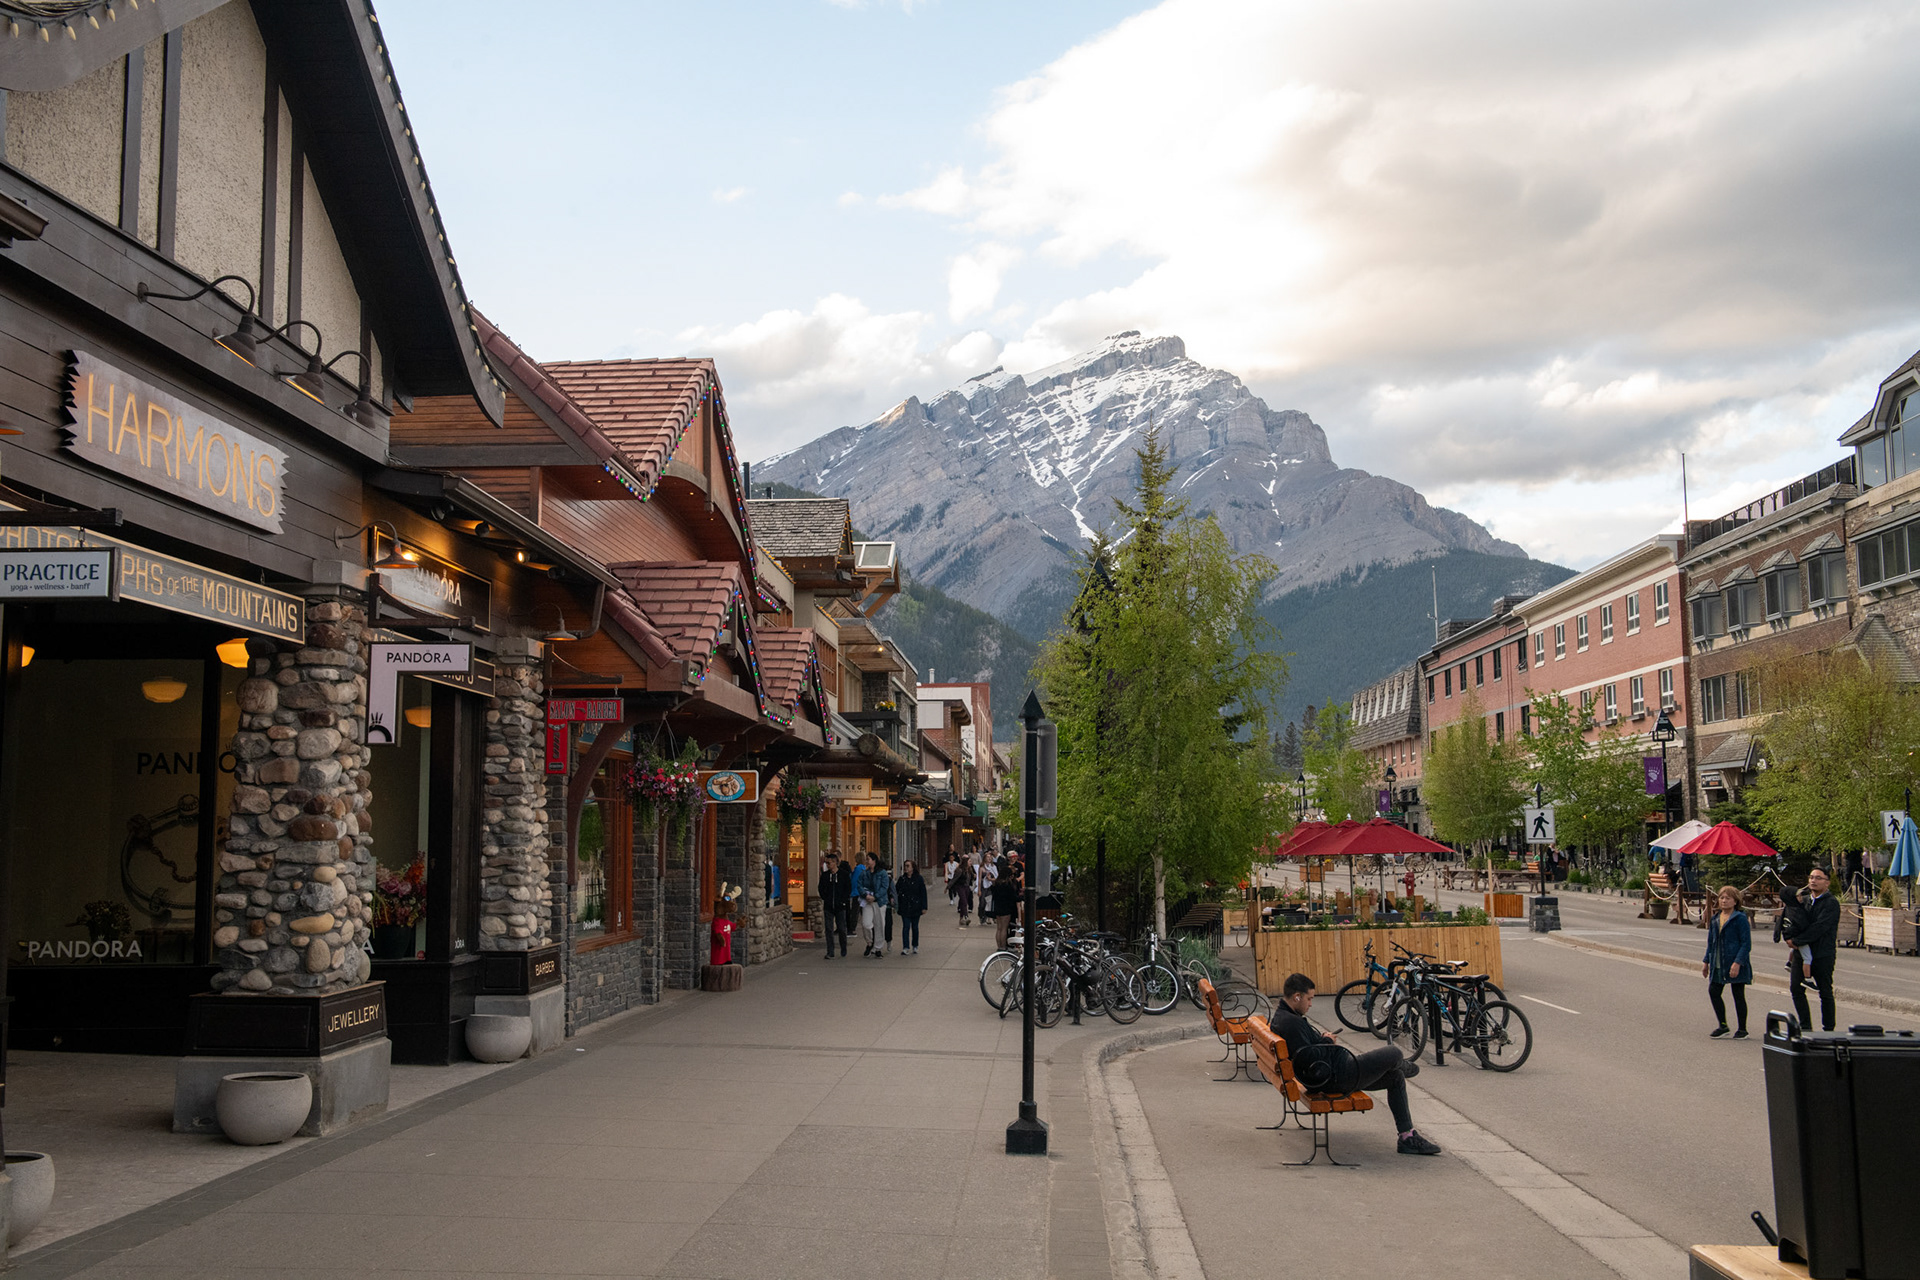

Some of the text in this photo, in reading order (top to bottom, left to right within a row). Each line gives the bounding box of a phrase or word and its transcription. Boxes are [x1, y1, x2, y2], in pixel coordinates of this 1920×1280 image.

[87, 371, 276, 517] HARMONS
[3, 563, 100, 581] PRACTICE
[166, 577, 180, 596] OF
[181, 575, 199, 593] THE
[202, 578, 298, 632] MOUNTAINS
[386, 652, 452, 663] PANDORA
[549, 701, 617, 719] SALON BARBER
[28, 939, 143, 958] PANDORA
[535, 960, 555, 977] BARBER
[329, 1004, 380, 1033] JEWELLERY
